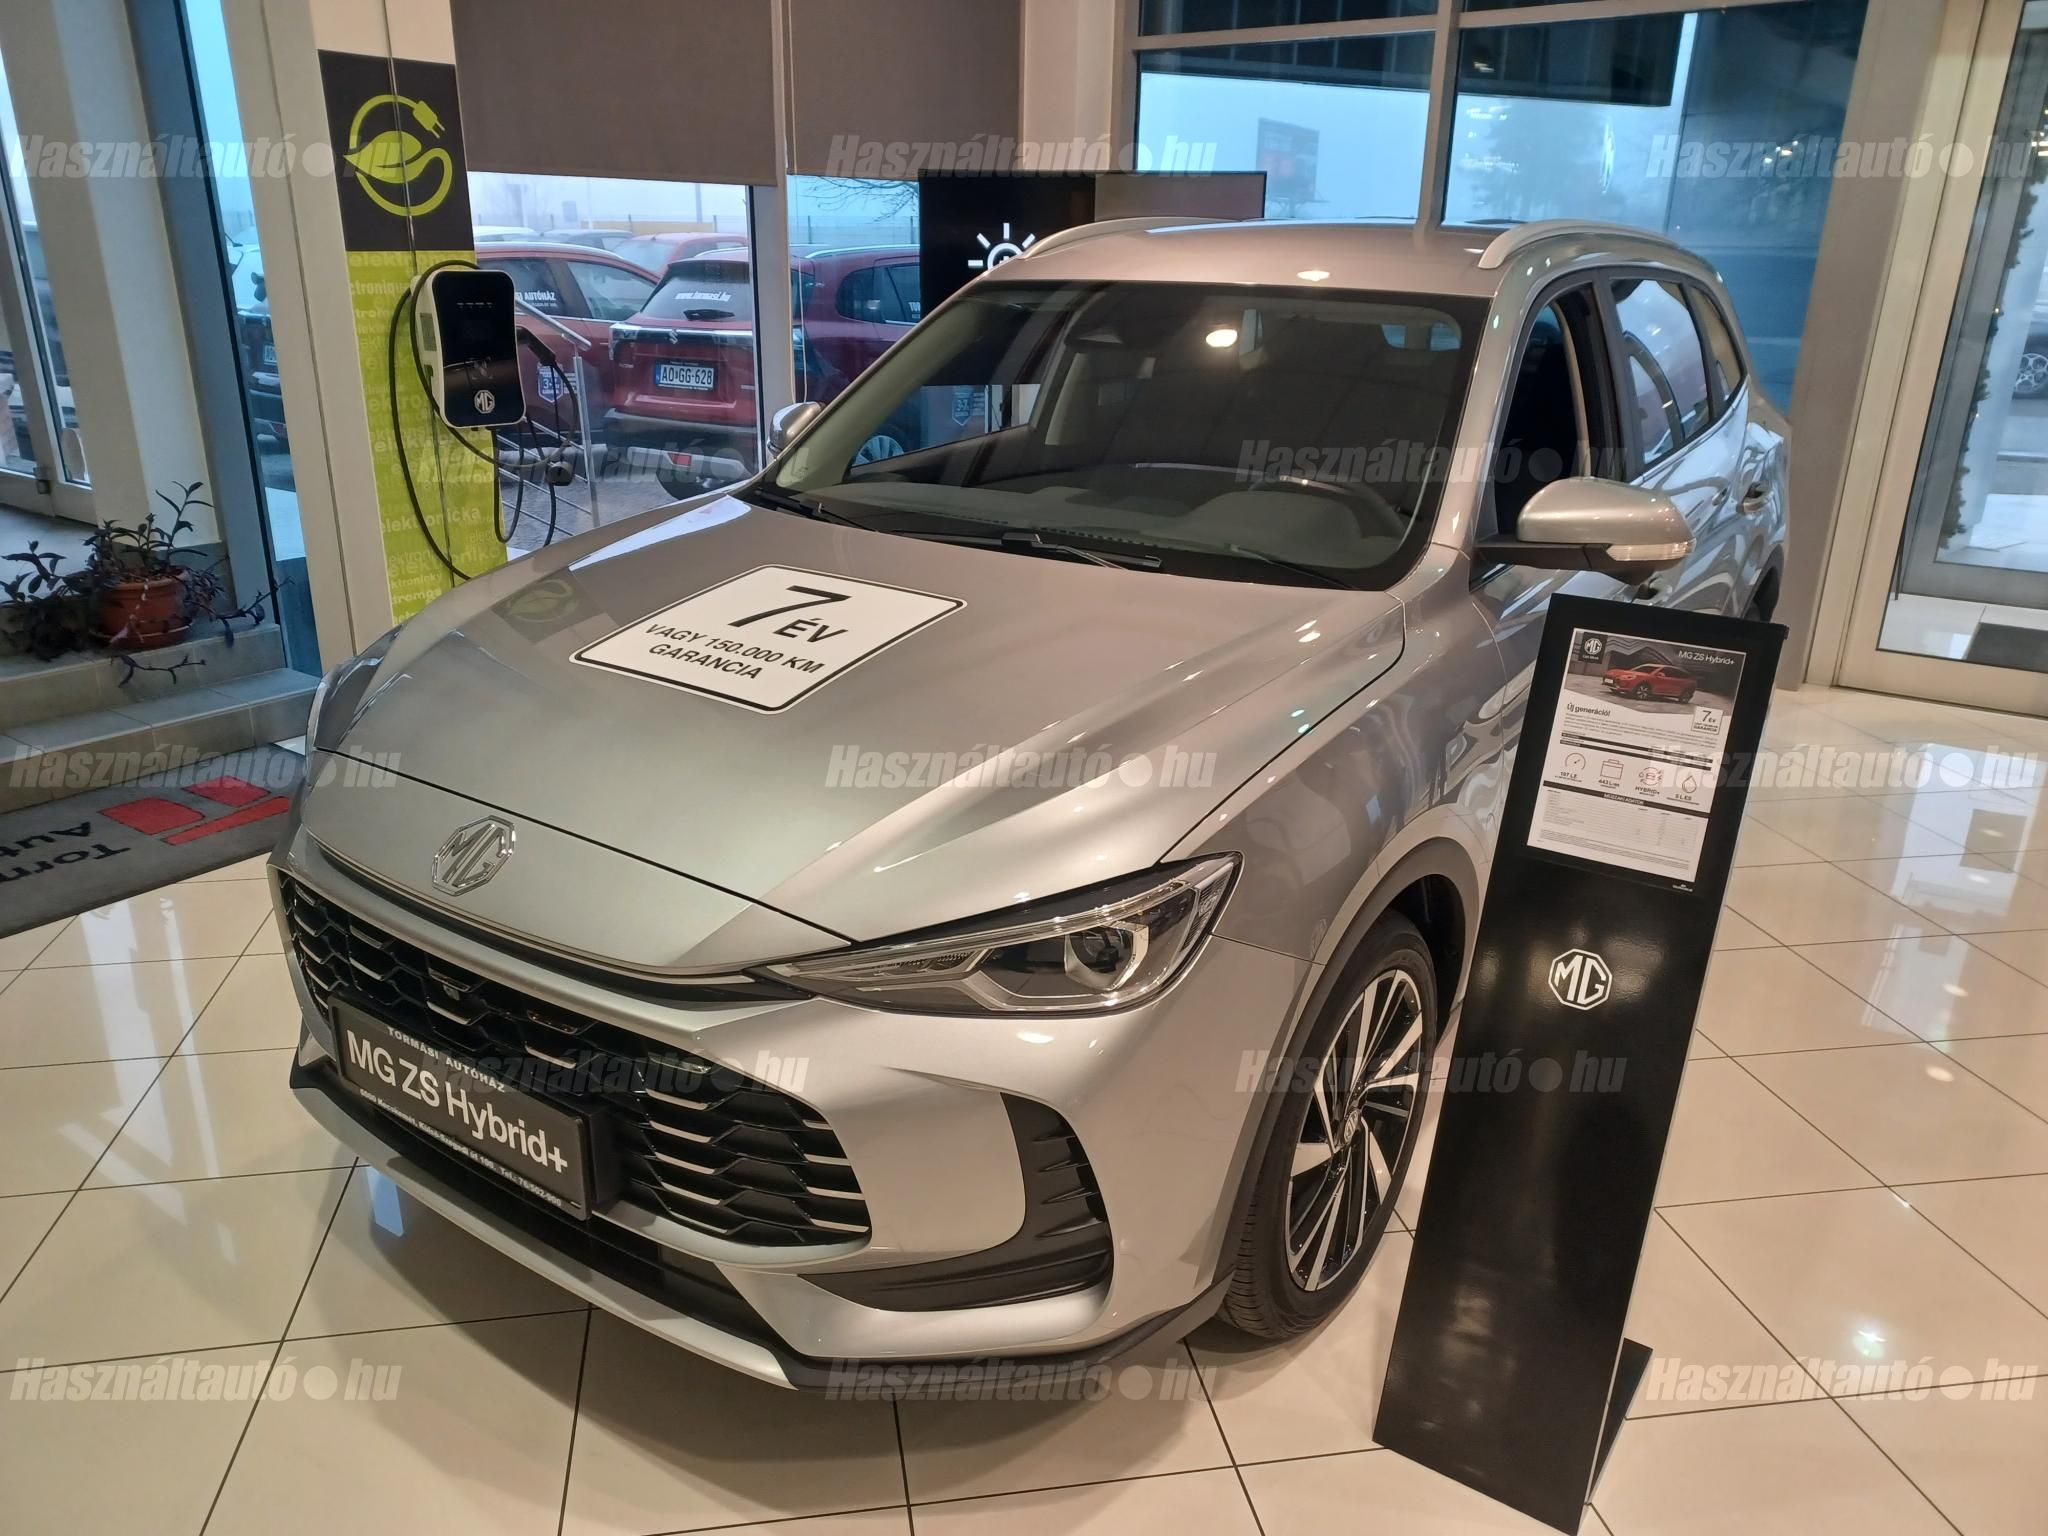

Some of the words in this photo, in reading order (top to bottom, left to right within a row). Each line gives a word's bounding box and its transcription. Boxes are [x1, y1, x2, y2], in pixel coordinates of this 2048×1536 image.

[475, 391, 494, 413] MG
[728, 585, 851, 628] 7
[645, 624, 706, 644] VAGY
[704, 637, 784, 663] 150.000
[781, 656, 825, 674] KM
[774, 618, 849, 643] ÉV
[1585, 638, 1602, 655] MG
[648, 643, 763, 679] GARANCIA
[1678, 650, 1693, 660] MG
[1702, 710, 1711, 722] 7
[436, 818, 512, 892] MG
[1550, 951, 1610, 1009] MG
[387, 1026, 440, 1059] TORMÁSI
[445, 1056, 506, 1094] AUTÓHÁZ
[346, 1029, 397, 1087] MG
[399, 1057, 440, 1107] ZS
[445, 1081, 569, 1175] Hybrid+
